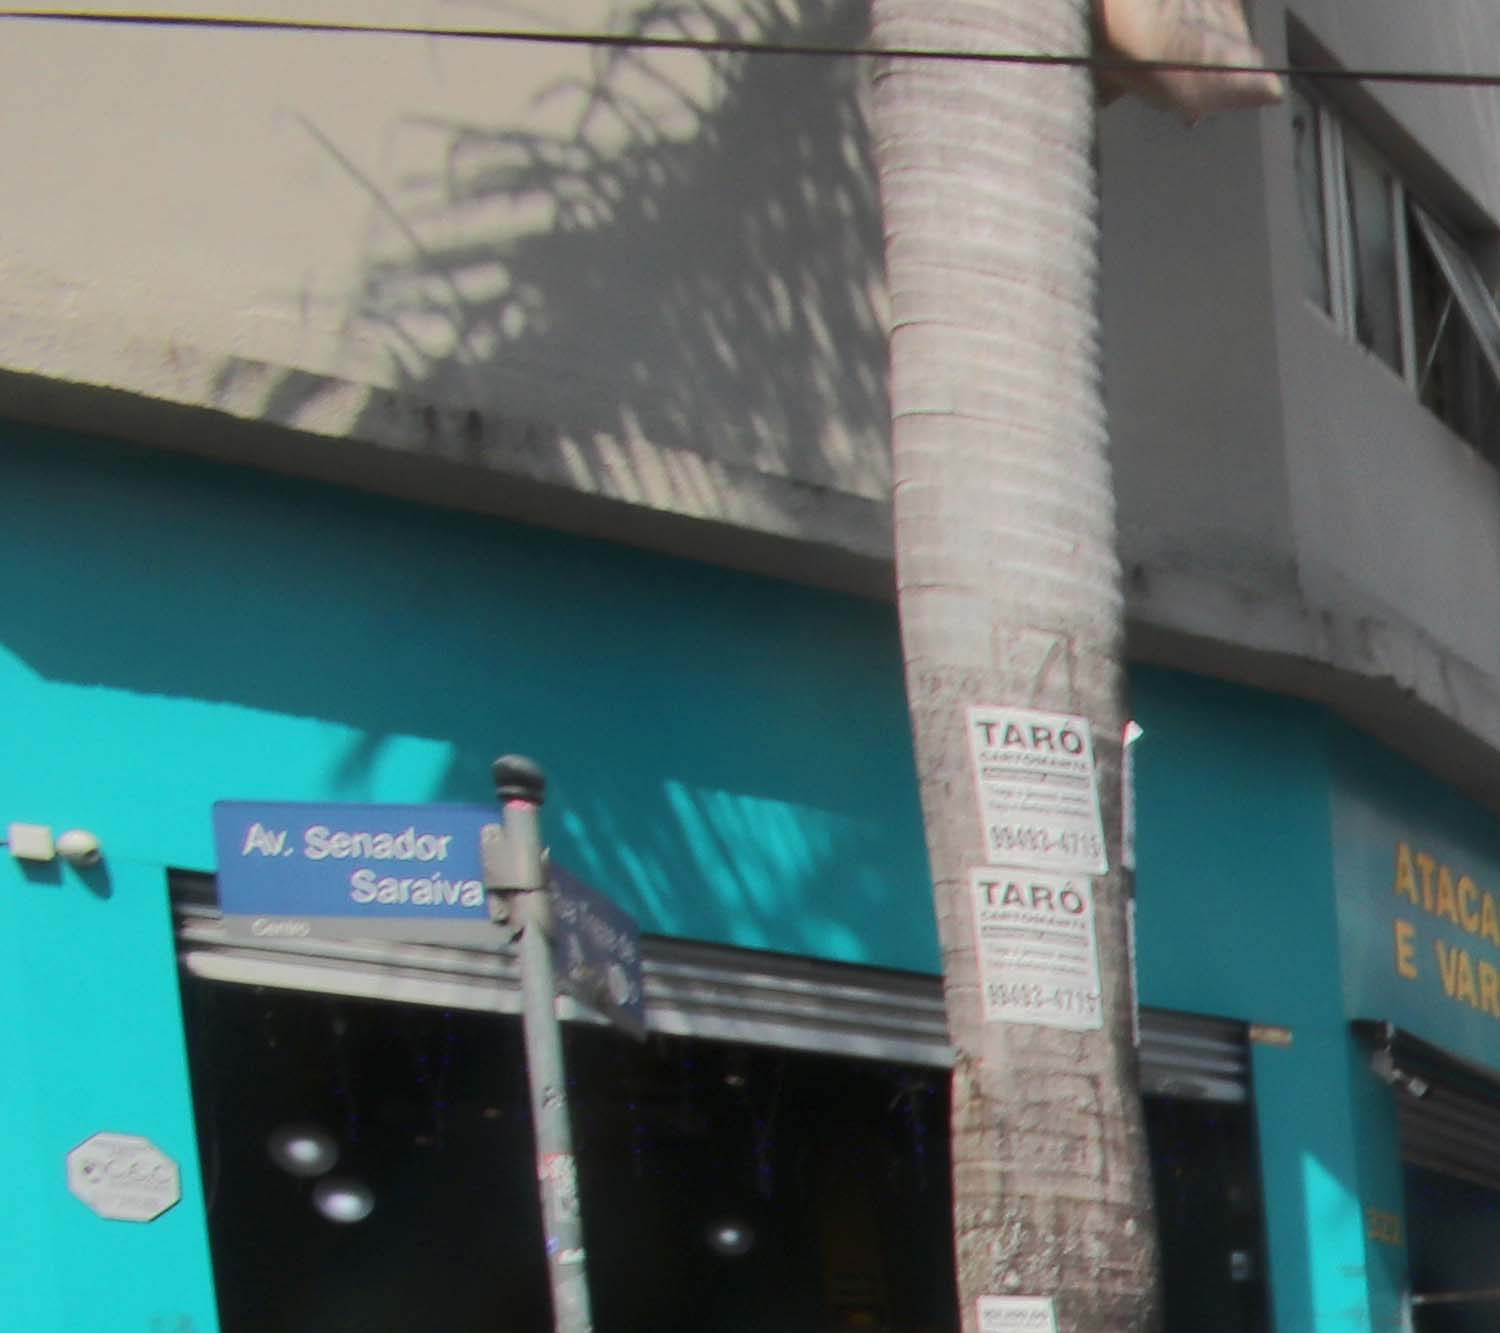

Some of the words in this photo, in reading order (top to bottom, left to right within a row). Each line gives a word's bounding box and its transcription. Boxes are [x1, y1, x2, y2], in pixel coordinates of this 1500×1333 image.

[976, 720, 1083, 756] TARÓ
[243, 823, 294, 858] Av.
[303, 825, 452, 862] Senador
[350, 868, 484, 908] Saraiva
[978, 880, 1085, 914] TARÓ
[1394, 918, 1419, 980] E
